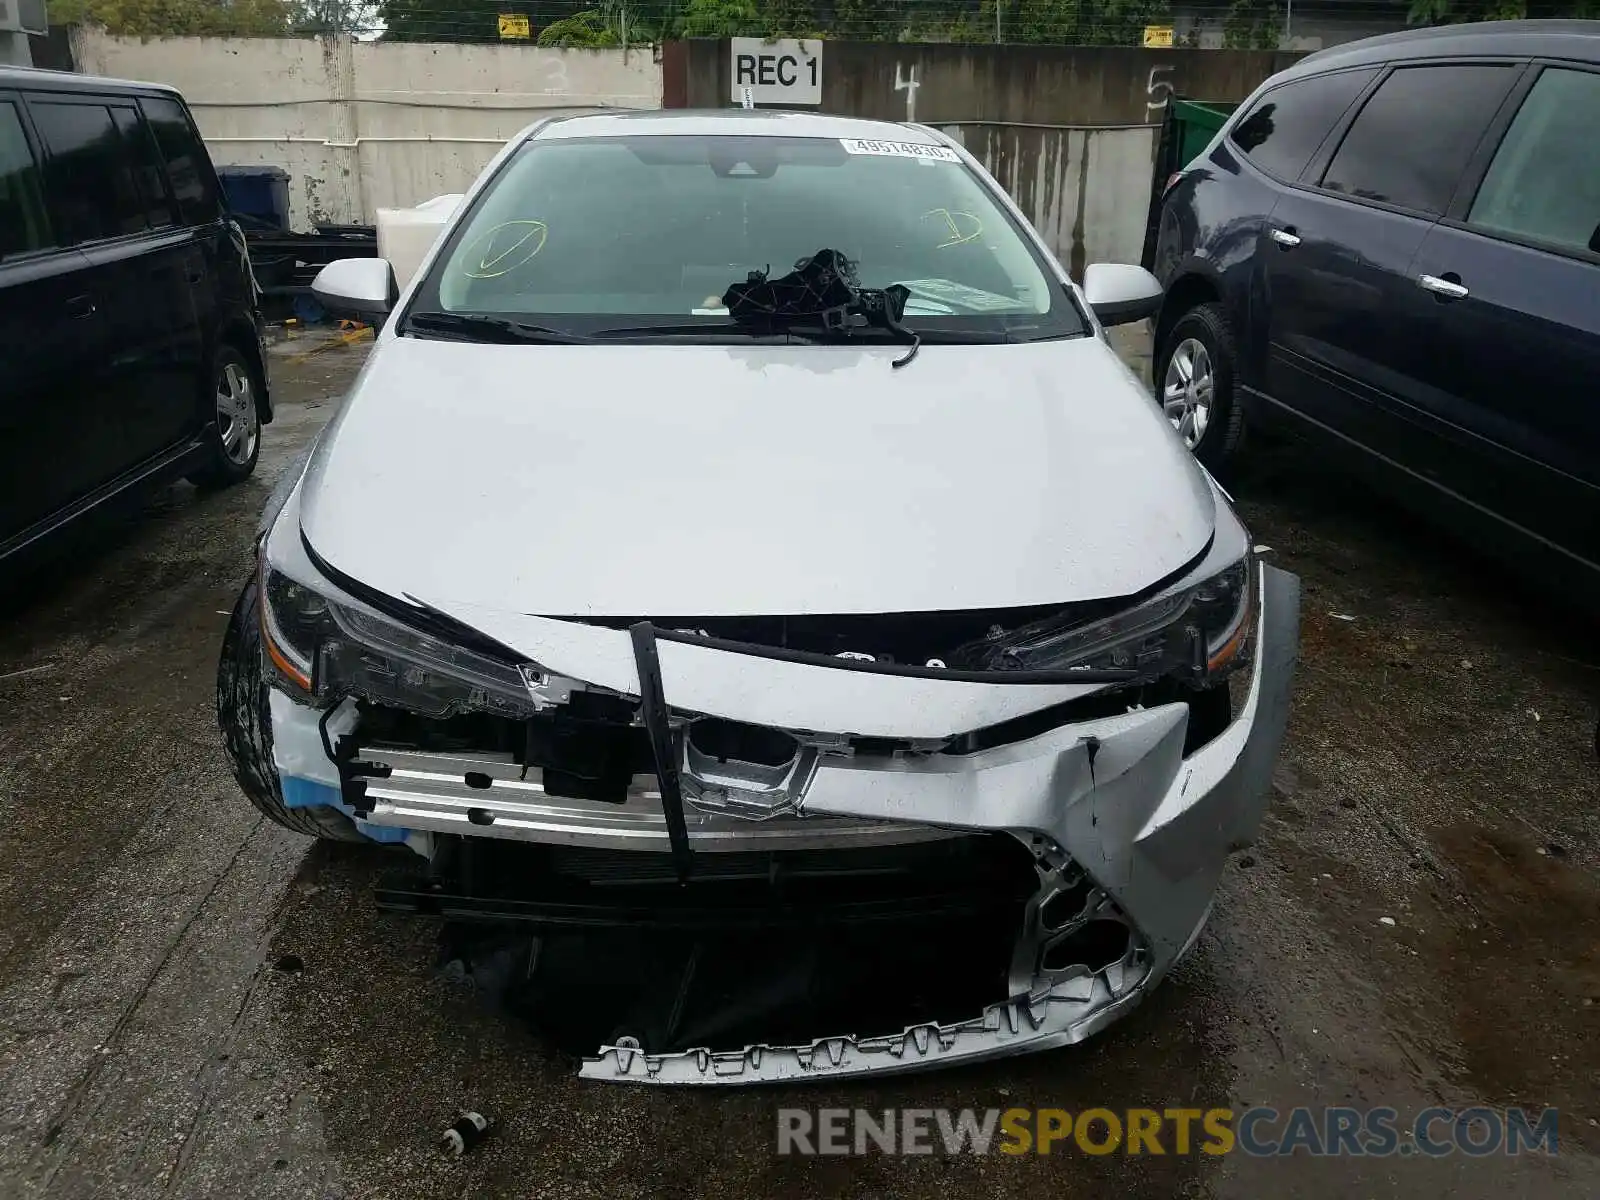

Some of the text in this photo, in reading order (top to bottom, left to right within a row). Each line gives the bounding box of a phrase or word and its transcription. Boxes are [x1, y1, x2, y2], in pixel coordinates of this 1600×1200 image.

[736, 54, 817, 87] REC 1
[895, 60, 921, 117] 4
[1147, 65, 1176, 110] 5
